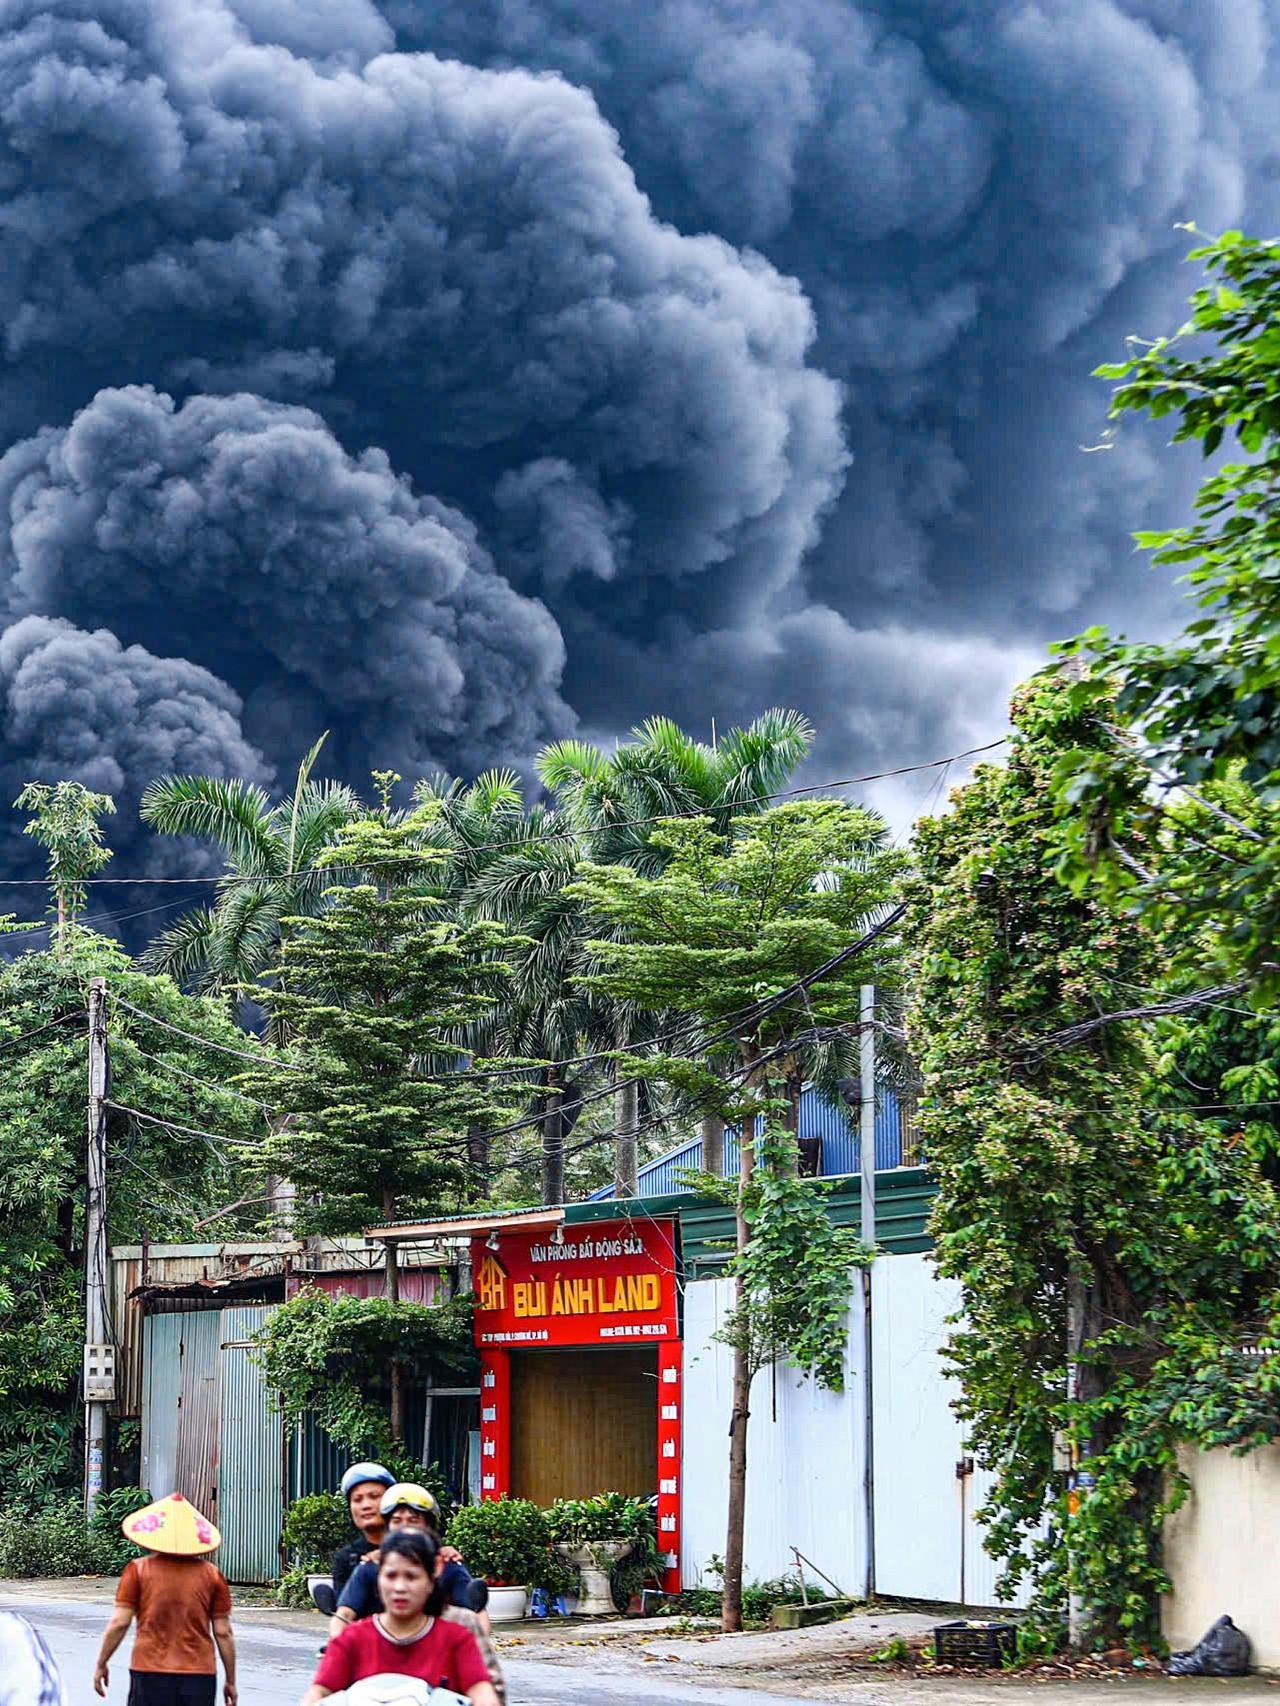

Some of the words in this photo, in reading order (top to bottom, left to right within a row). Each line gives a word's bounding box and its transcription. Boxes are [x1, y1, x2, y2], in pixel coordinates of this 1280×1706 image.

[513, 1274, 546, 1317] BÙI
[552, 1273, 594, 1315] ÁNH
[598, 1274, 661, 1313] LAND
